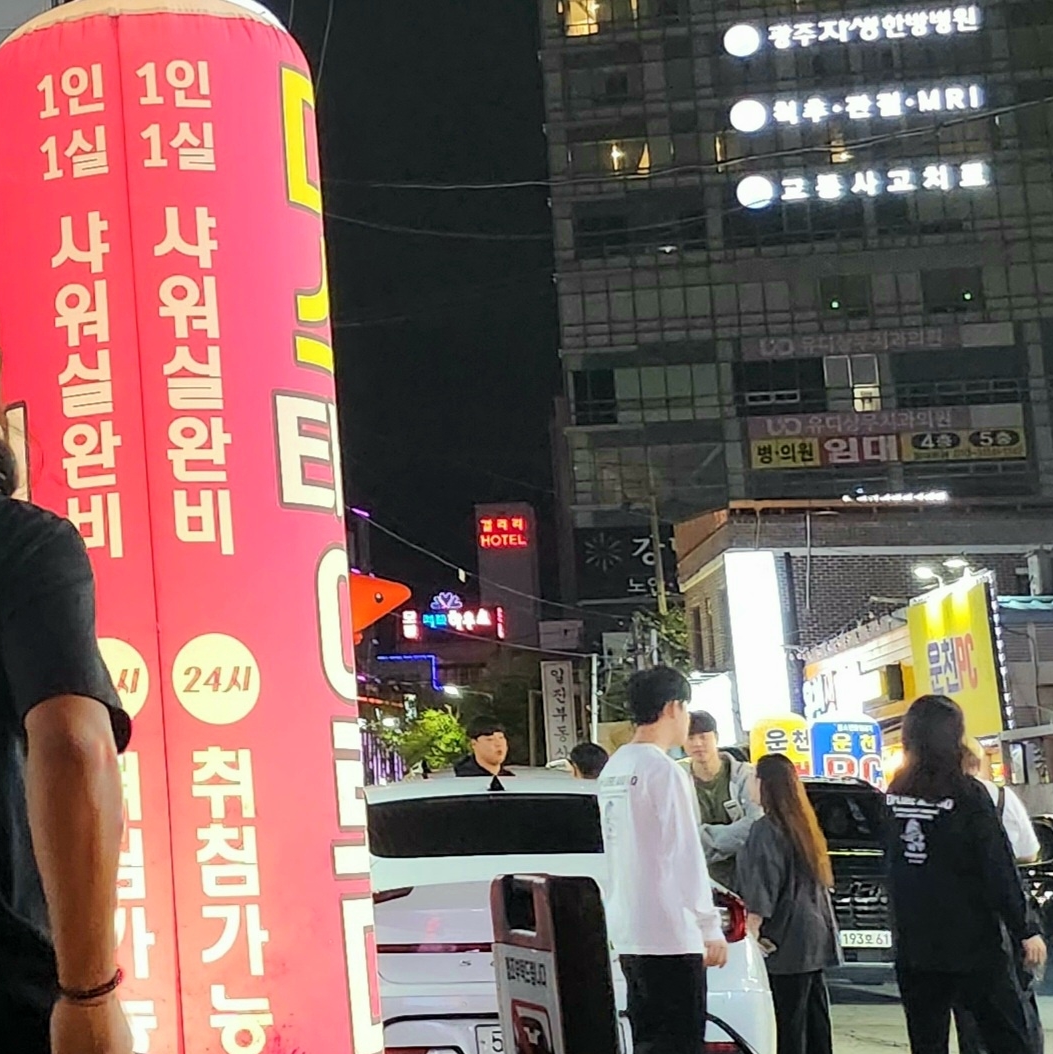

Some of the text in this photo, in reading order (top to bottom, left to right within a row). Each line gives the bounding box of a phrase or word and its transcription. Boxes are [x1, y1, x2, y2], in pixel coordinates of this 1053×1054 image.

[36, 63, 106, 119] 1인
[135, 59, 213, 109] 1인
[39, 125, 110, 181] 1실
[140, 122, 217, 171] 1실
[51, 210, 124, 559] 샤워실완비
[153, 206, 234, 556] 샤워실완비
[823, 434, 899, 465] 임대
[480, 534, 528, 548] HOTEL
[182, 665, 252, 693] 24시
[927, 633, 978, 696] 운천PC
[765, 730, 810, 752] 운천
